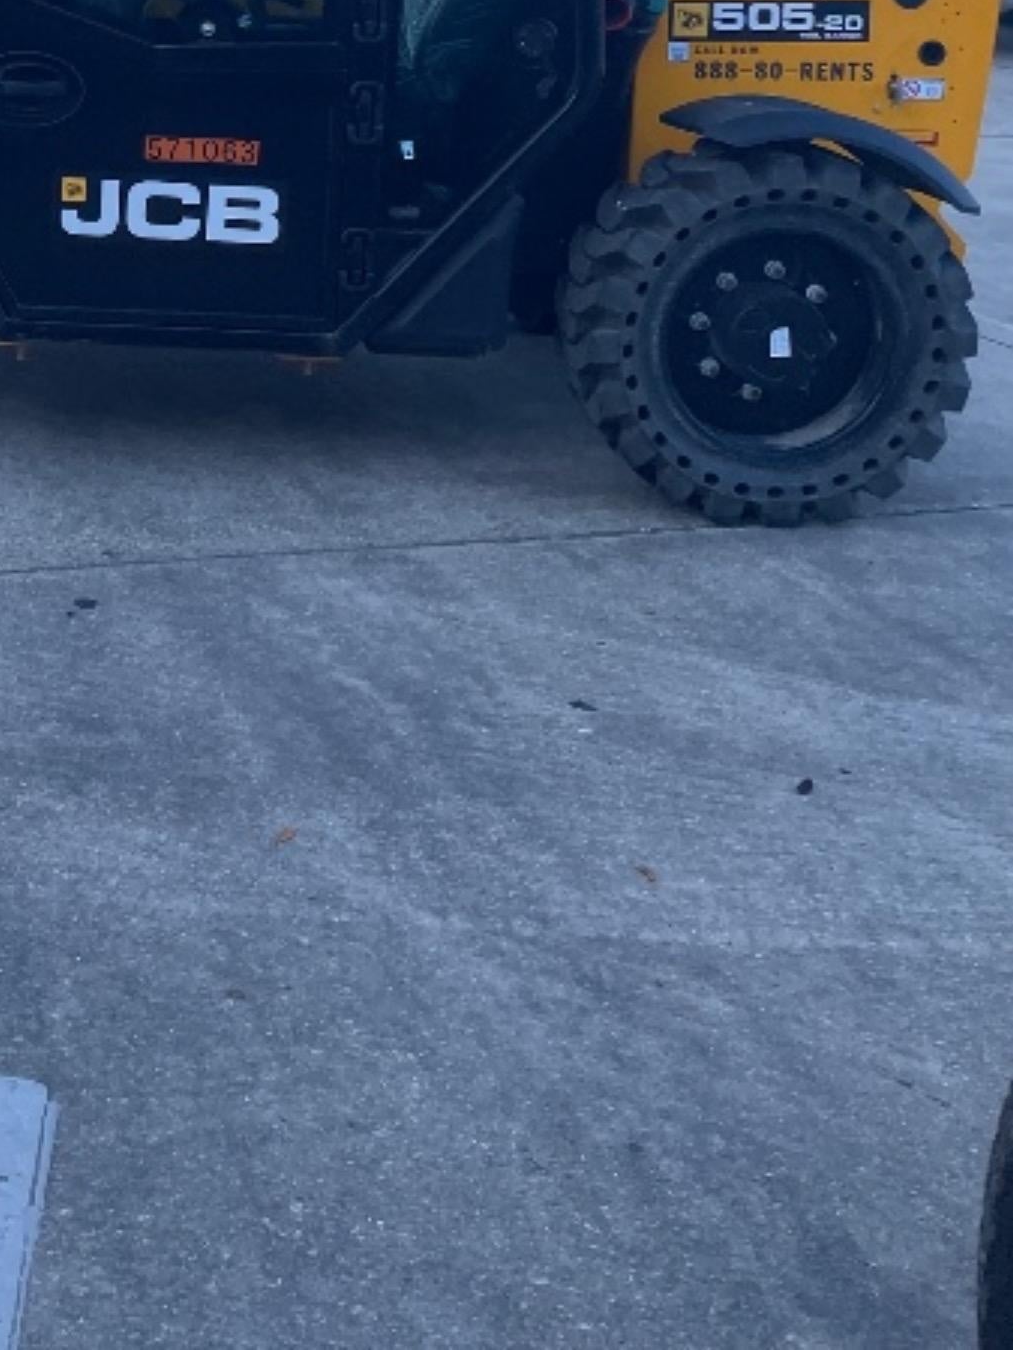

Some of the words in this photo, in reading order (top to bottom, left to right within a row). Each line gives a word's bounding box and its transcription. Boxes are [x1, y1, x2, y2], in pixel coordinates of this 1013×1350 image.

[694, 60, 874, 82] 888-80-RENTS
[147, 138, 256, 163] 571063
[61, 180, 279, 244] JCB
